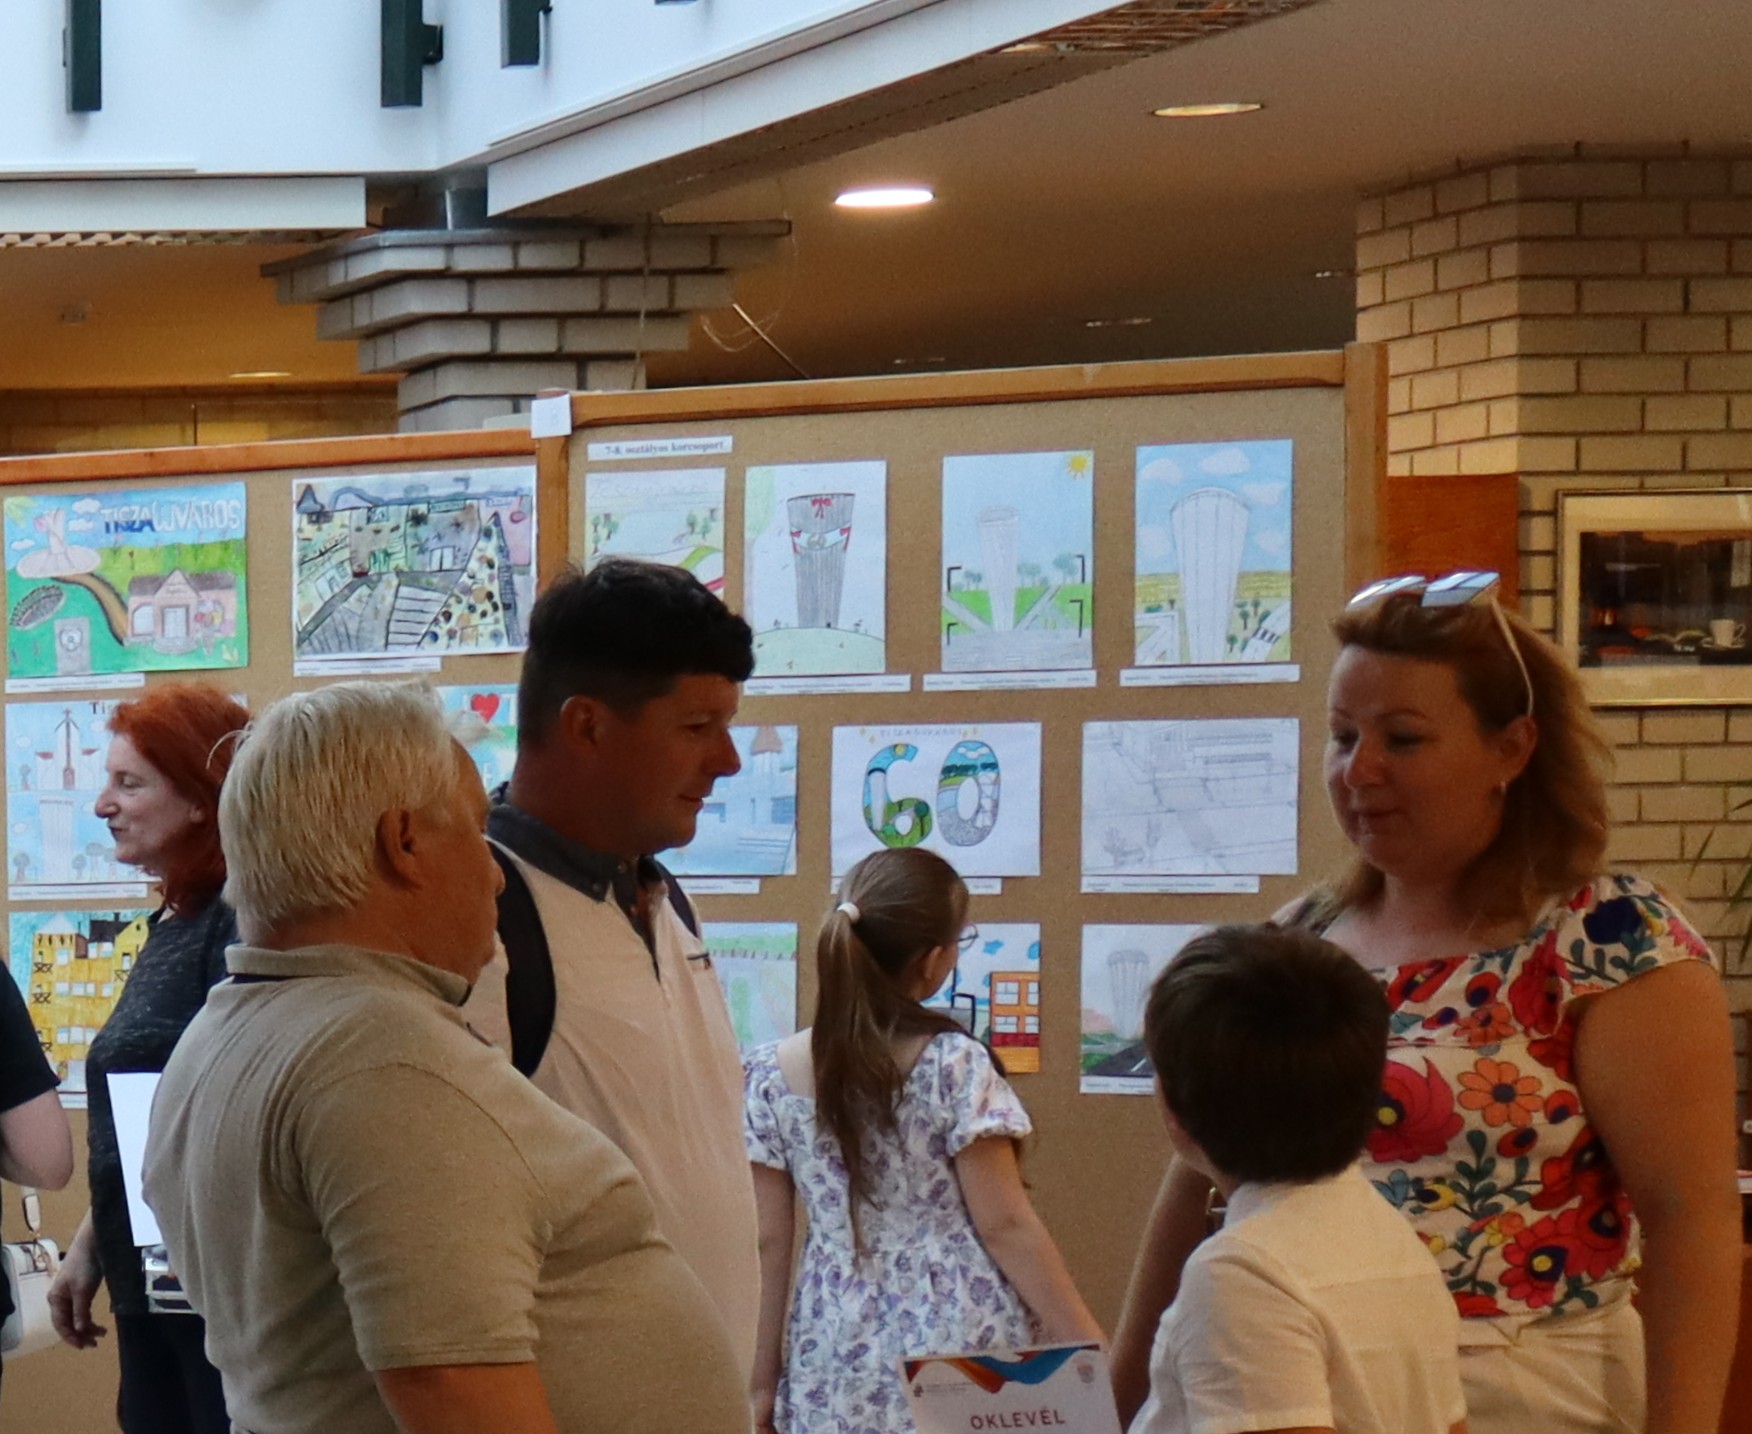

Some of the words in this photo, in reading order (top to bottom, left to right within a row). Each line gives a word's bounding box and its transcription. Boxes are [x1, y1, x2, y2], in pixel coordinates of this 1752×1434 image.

[671, 442, 724, 452] korcsoport
[862, 739, 1002, 848] 60
[969, 1406, 1067, 1430] OKLEVÉL
